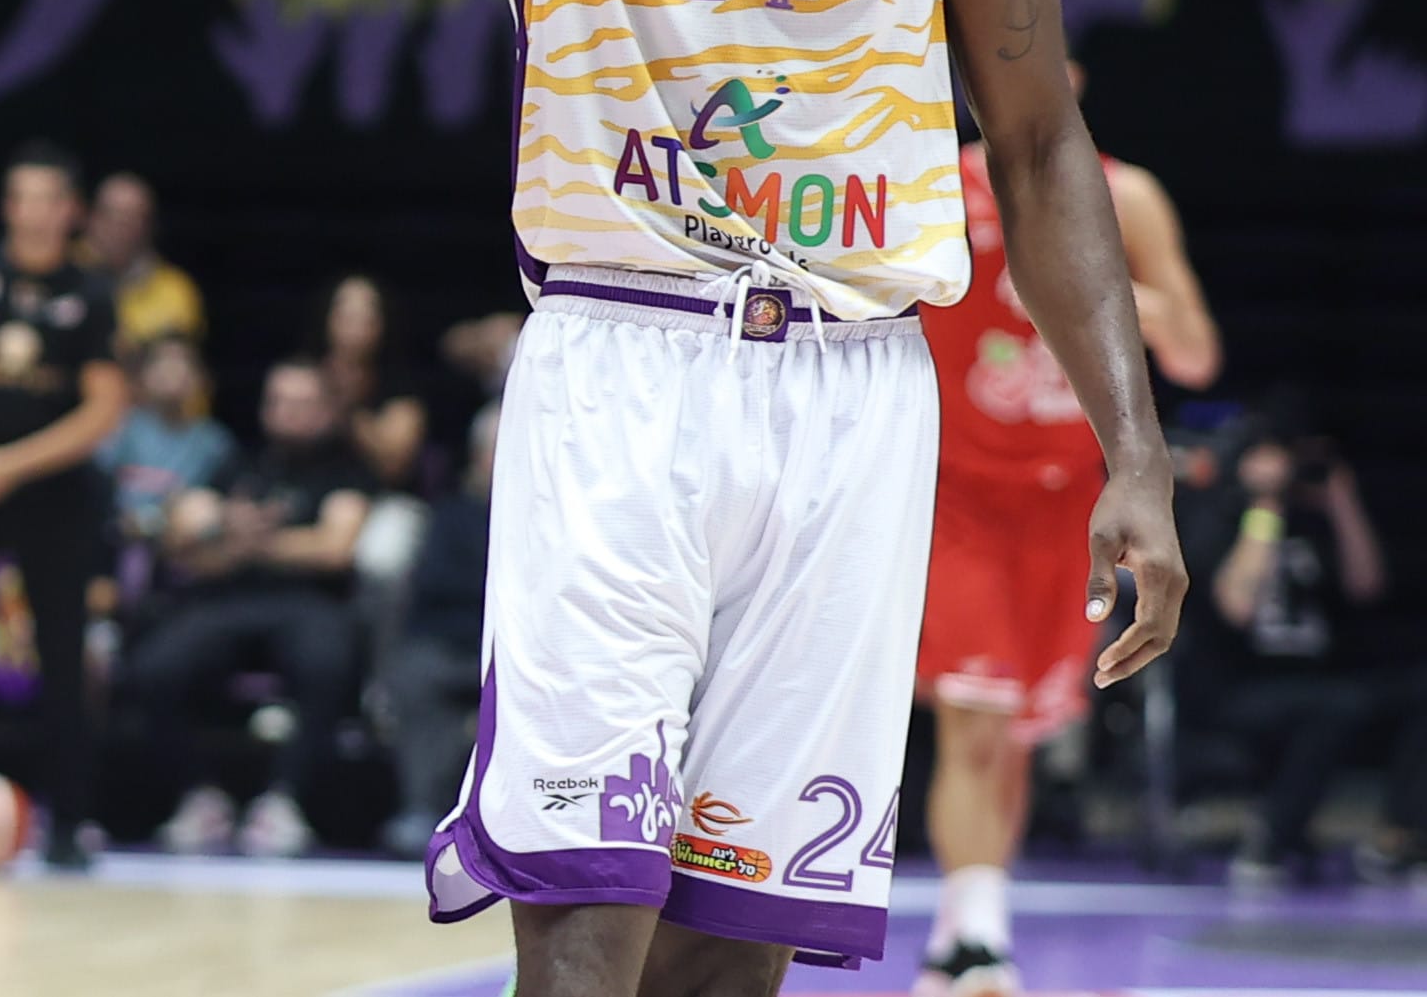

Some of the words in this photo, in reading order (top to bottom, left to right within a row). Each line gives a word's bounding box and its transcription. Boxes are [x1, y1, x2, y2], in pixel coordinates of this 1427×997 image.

[533, 777, 599, 792] Reebok
[676, 842, 737, 872] Winner
[712, 847, 737, 860] ליגת
[738, 859, 756, 876] סל
